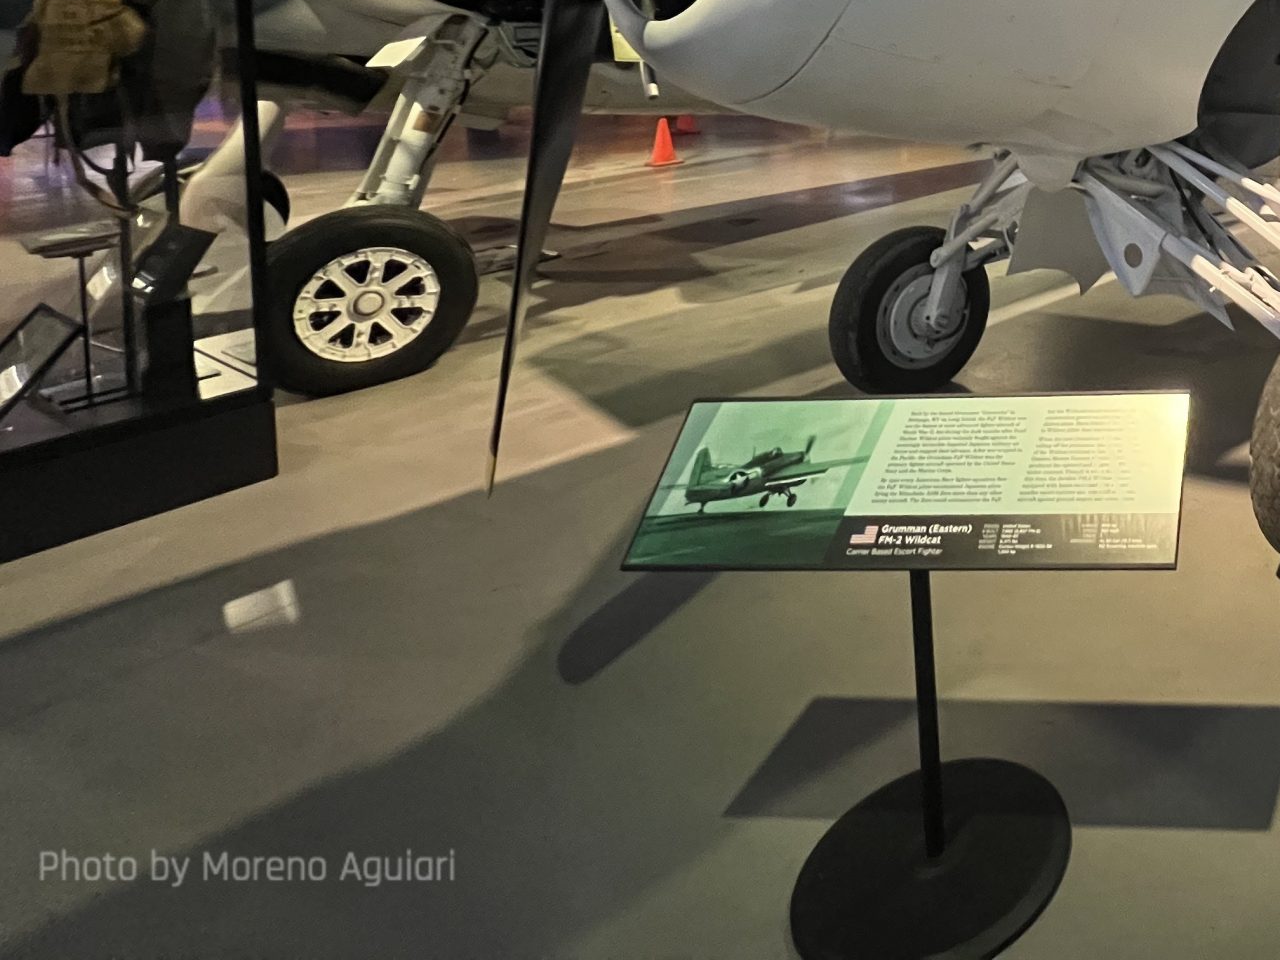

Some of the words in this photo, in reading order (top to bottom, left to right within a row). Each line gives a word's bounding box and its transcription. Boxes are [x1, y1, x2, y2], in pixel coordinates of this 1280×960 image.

[881, 524, 928, 534] Grumman
[928, 523, 973, 535] (Eastern)
[878, 535, 902, 545] FM-2
[905, 535, 942, 545] Wildcat
